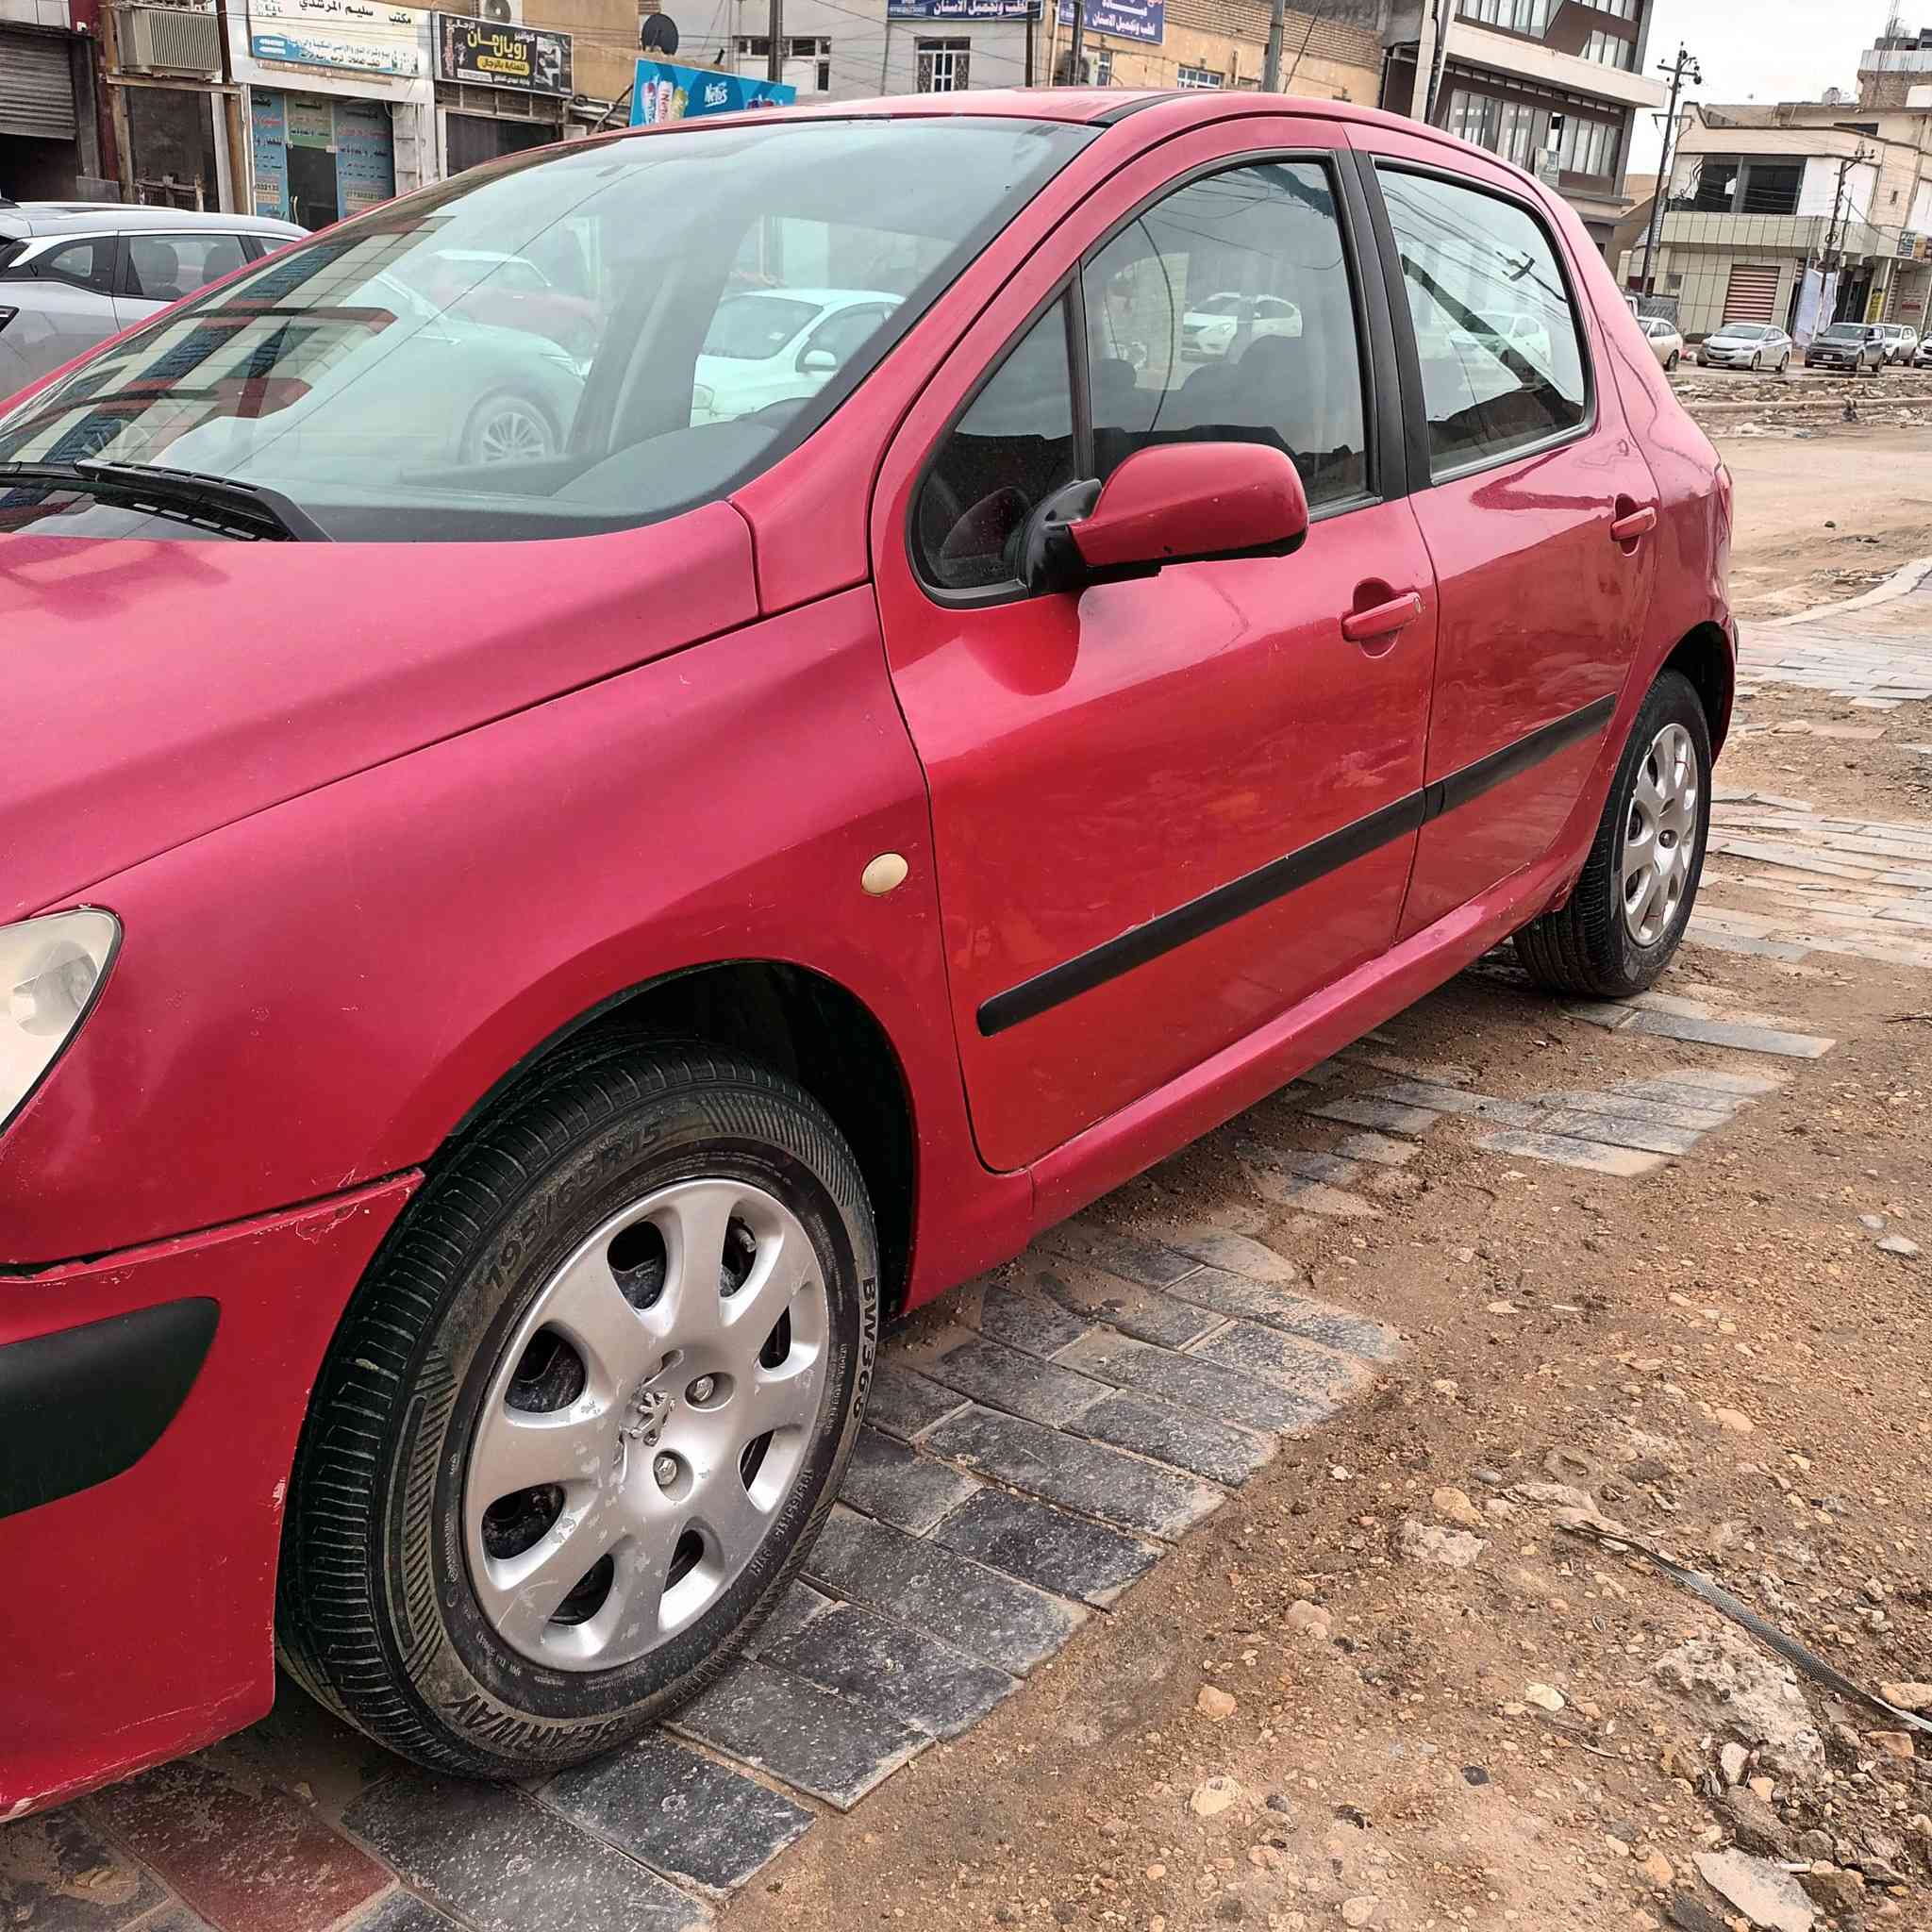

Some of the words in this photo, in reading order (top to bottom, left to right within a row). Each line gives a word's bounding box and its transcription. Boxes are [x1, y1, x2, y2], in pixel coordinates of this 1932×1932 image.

[344, 5, 375, 18] سليم
[388, 12, 412, 25] مكتب
[467, 26, 500, 48] مان
[493, 34, 527, 60] رويال
